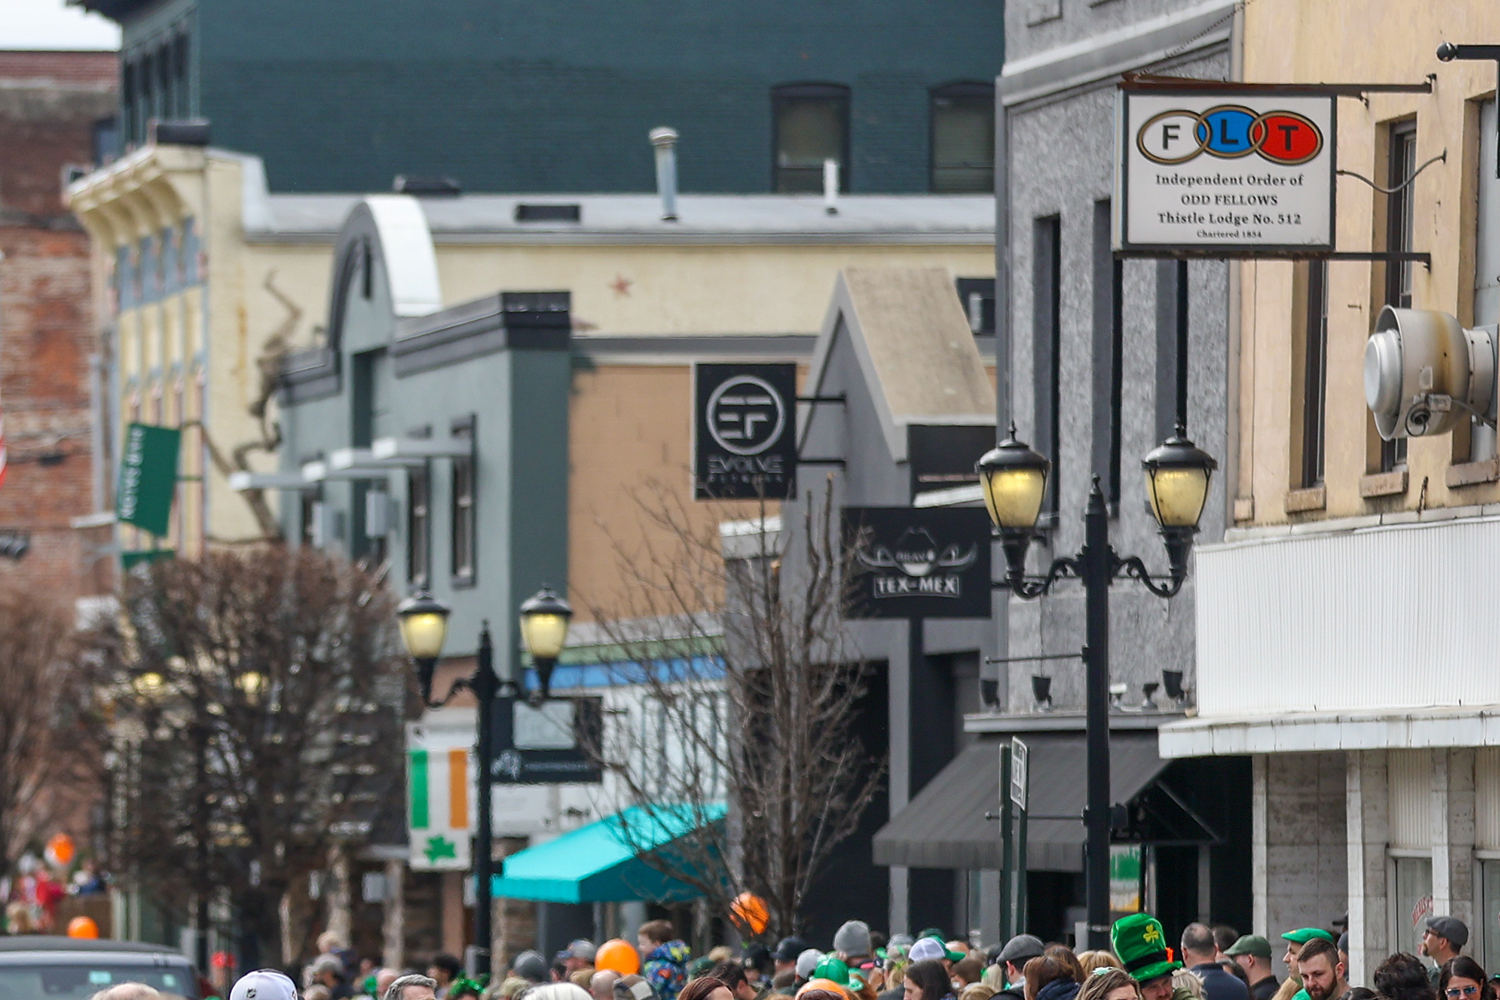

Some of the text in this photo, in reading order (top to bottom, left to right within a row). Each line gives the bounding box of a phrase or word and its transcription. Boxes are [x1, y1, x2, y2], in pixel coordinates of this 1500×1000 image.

[1162, 118, 1299, 151] F L T
[1156, 173, 1304, 188] Independent Order of
[1181, 194, 1278, 206] ODD FELLOWS
[1158, 211, 1302, 227] Thistle Lodge No. 512
[1196, 230, 1239, 239] Chartered
[707, 455, 784, 474] EVOLVE
[876, 576, 957, 594] TEX-MEX
